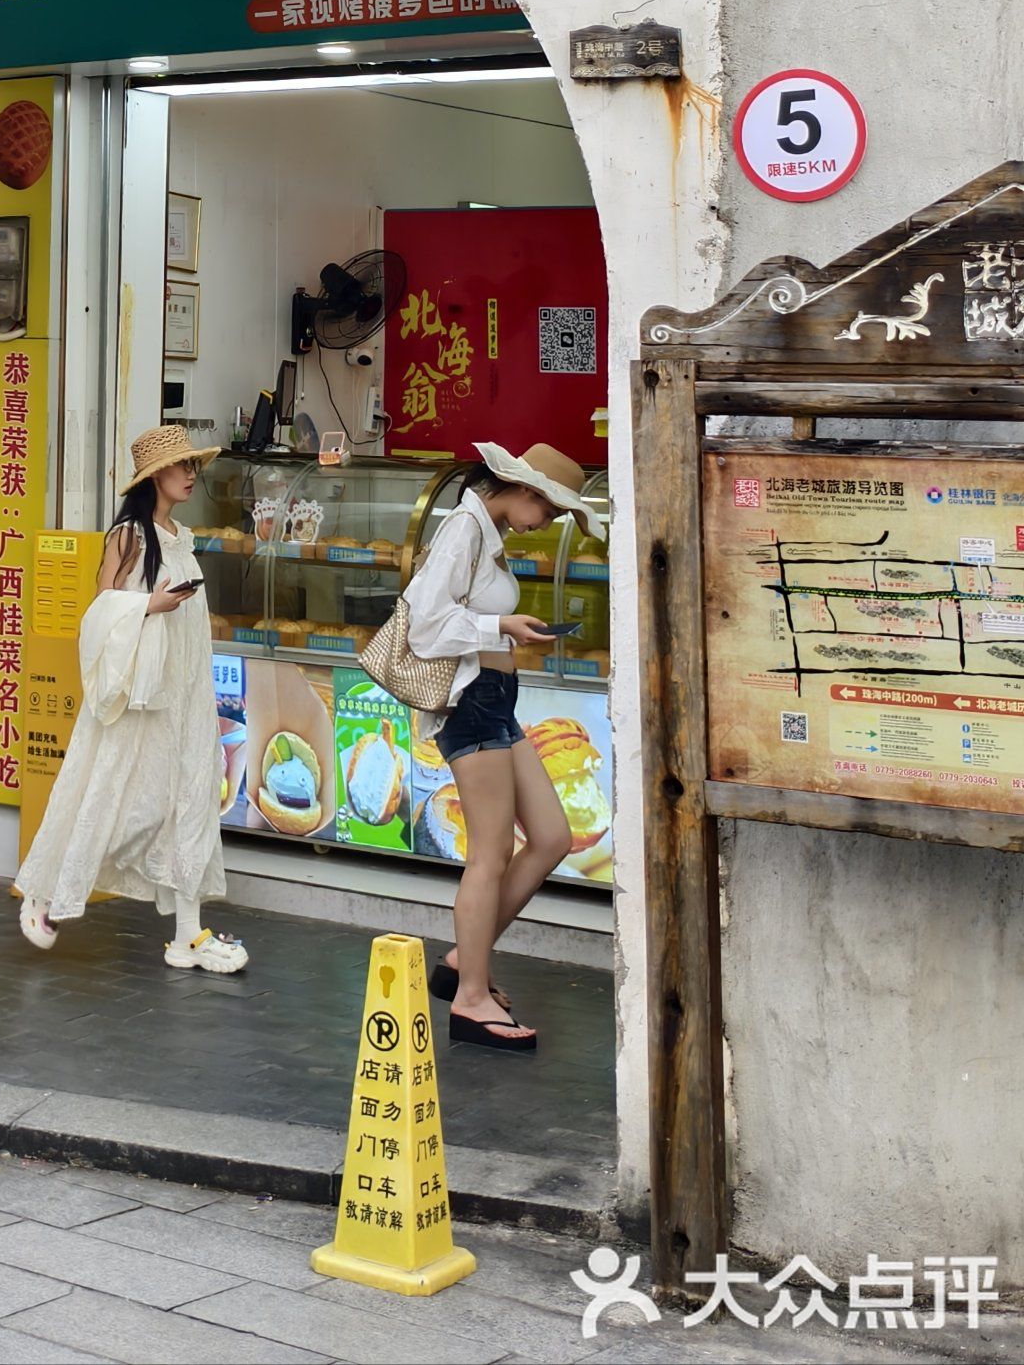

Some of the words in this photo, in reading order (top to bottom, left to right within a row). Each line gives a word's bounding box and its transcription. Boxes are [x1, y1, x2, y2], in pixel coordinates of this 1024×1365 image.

[636, 39, 664, 57] 2号
[776, 88, 823, 156] 5
[766, 158, 837, 179] 限速5KM
[398, 288, 474, 424] 北海翁
[766, 477, 904, 497] 北海老城旅游导览图
[948, 487, 996, 499] 桂林银行
[345, 1199, 404, 1232] 敬请谅解
[416, 1200, 448, 1233] 敬请谅解
